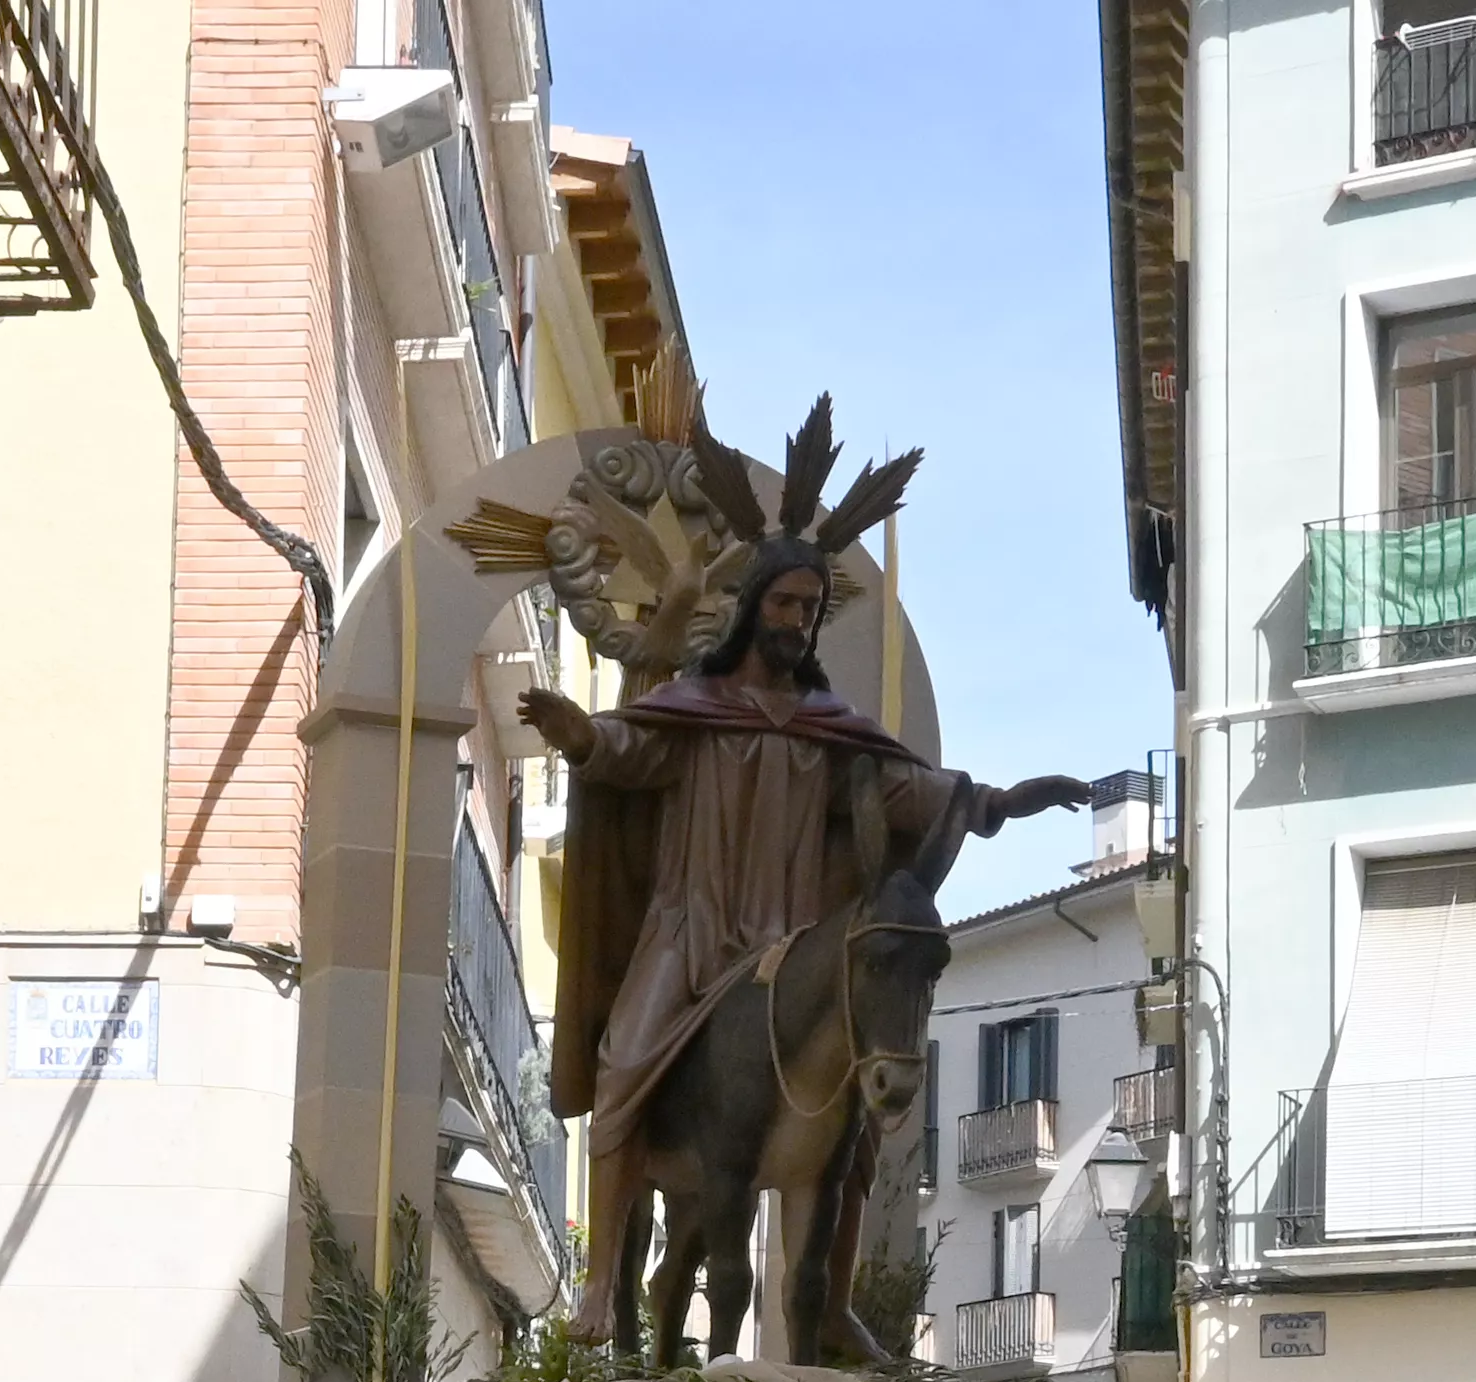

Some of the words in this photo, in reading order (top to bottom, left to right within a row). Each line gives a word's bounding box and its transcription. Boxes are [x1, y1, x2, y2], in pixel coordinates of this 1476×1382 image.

[62, 994, 130, 1014] CALLE
[50, 1018, 143, 1040] CUATRO
[39, 1046, 124, 1066] REYES
[1271, 1342, 1313, 1354] GOYA
